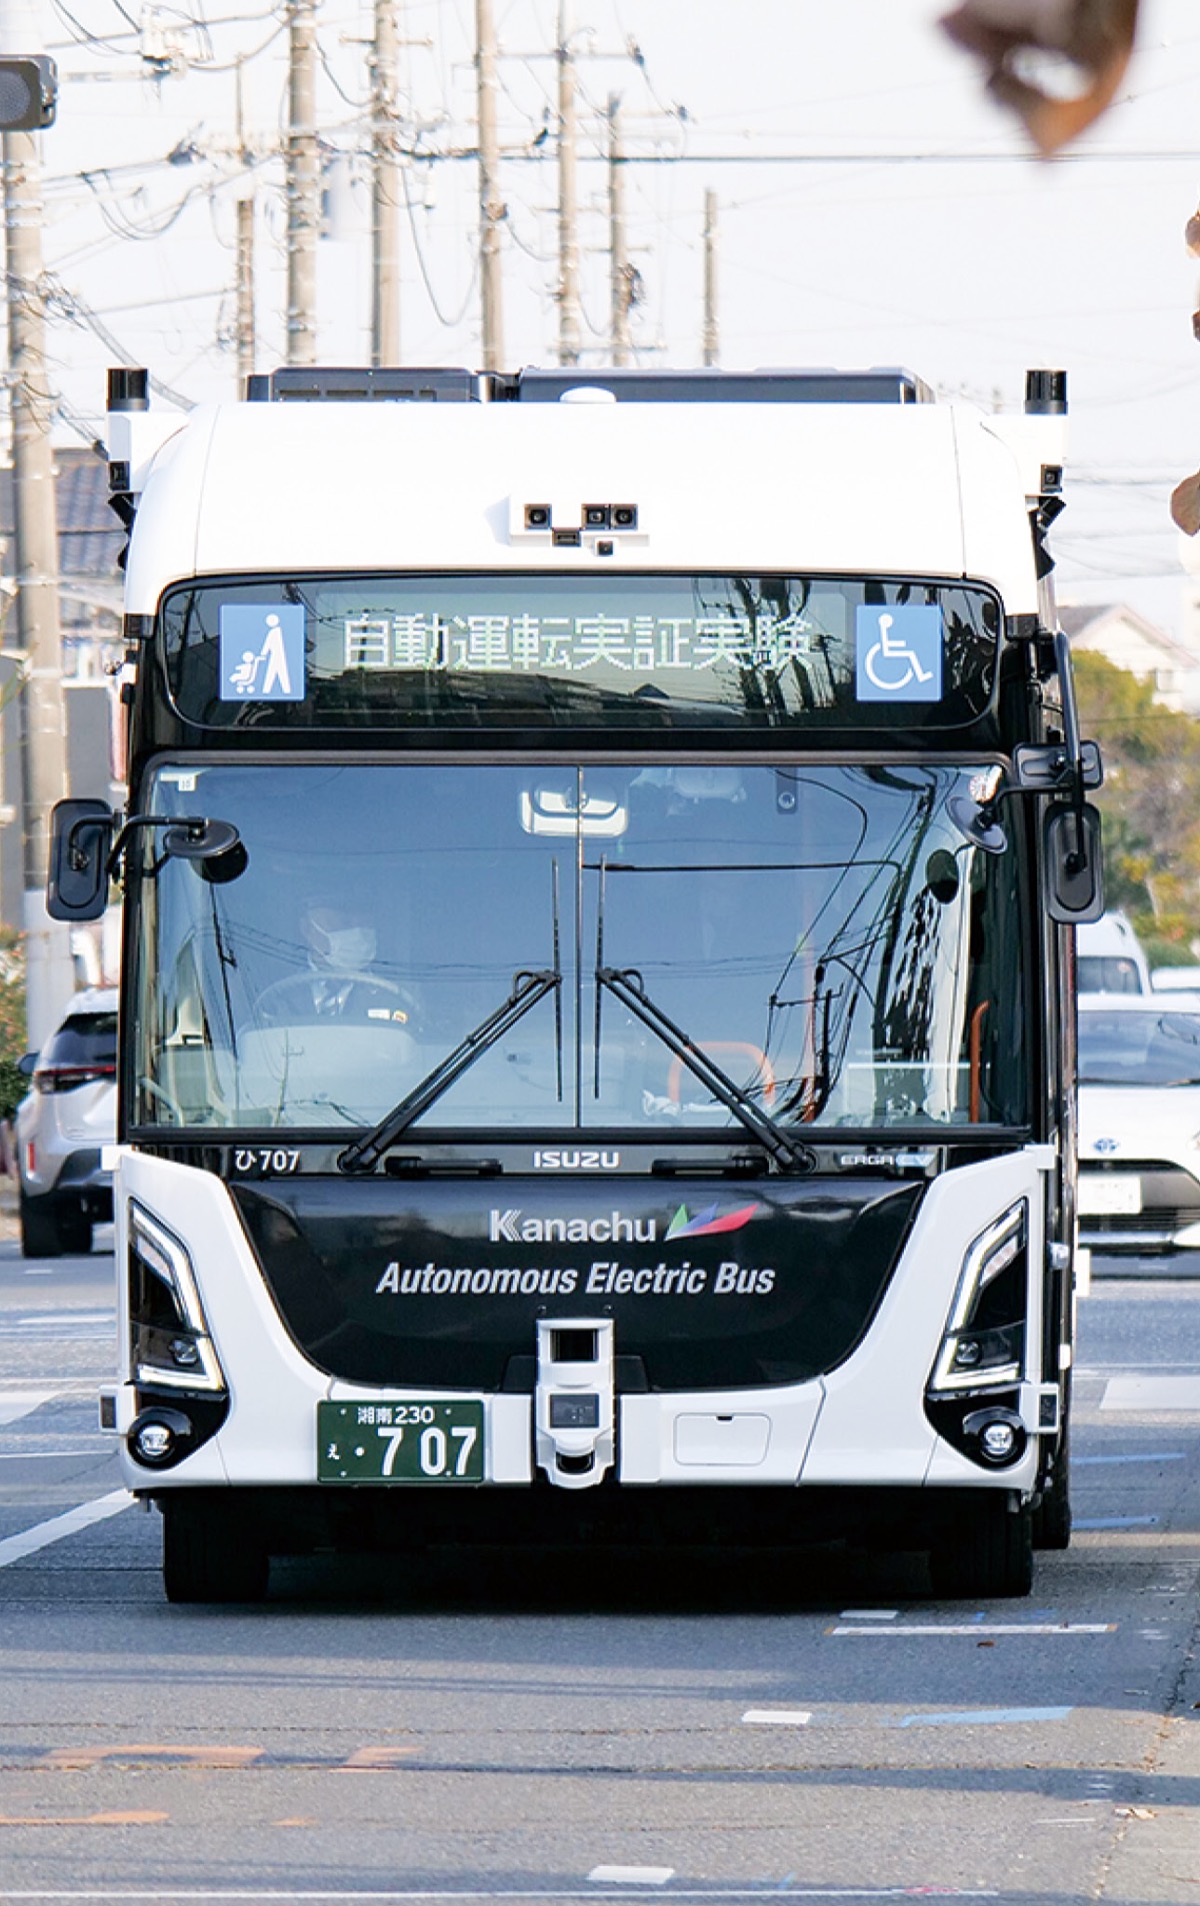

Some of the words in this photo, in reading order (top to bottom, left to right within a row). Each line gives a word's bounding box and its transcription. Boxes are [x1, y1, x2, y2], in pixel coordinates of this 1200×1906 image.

[343, 612, 813, 670] 自動運転実証実験
[533, 1151, 620, 1168] ISUZU
[489, 1209, 656, 1242] Kanachu
[375, 1261, 579, 1295] Autonomous
[585, 1261, 708, 1295] Electric
[713, 1261, 777, 1295] Bus
